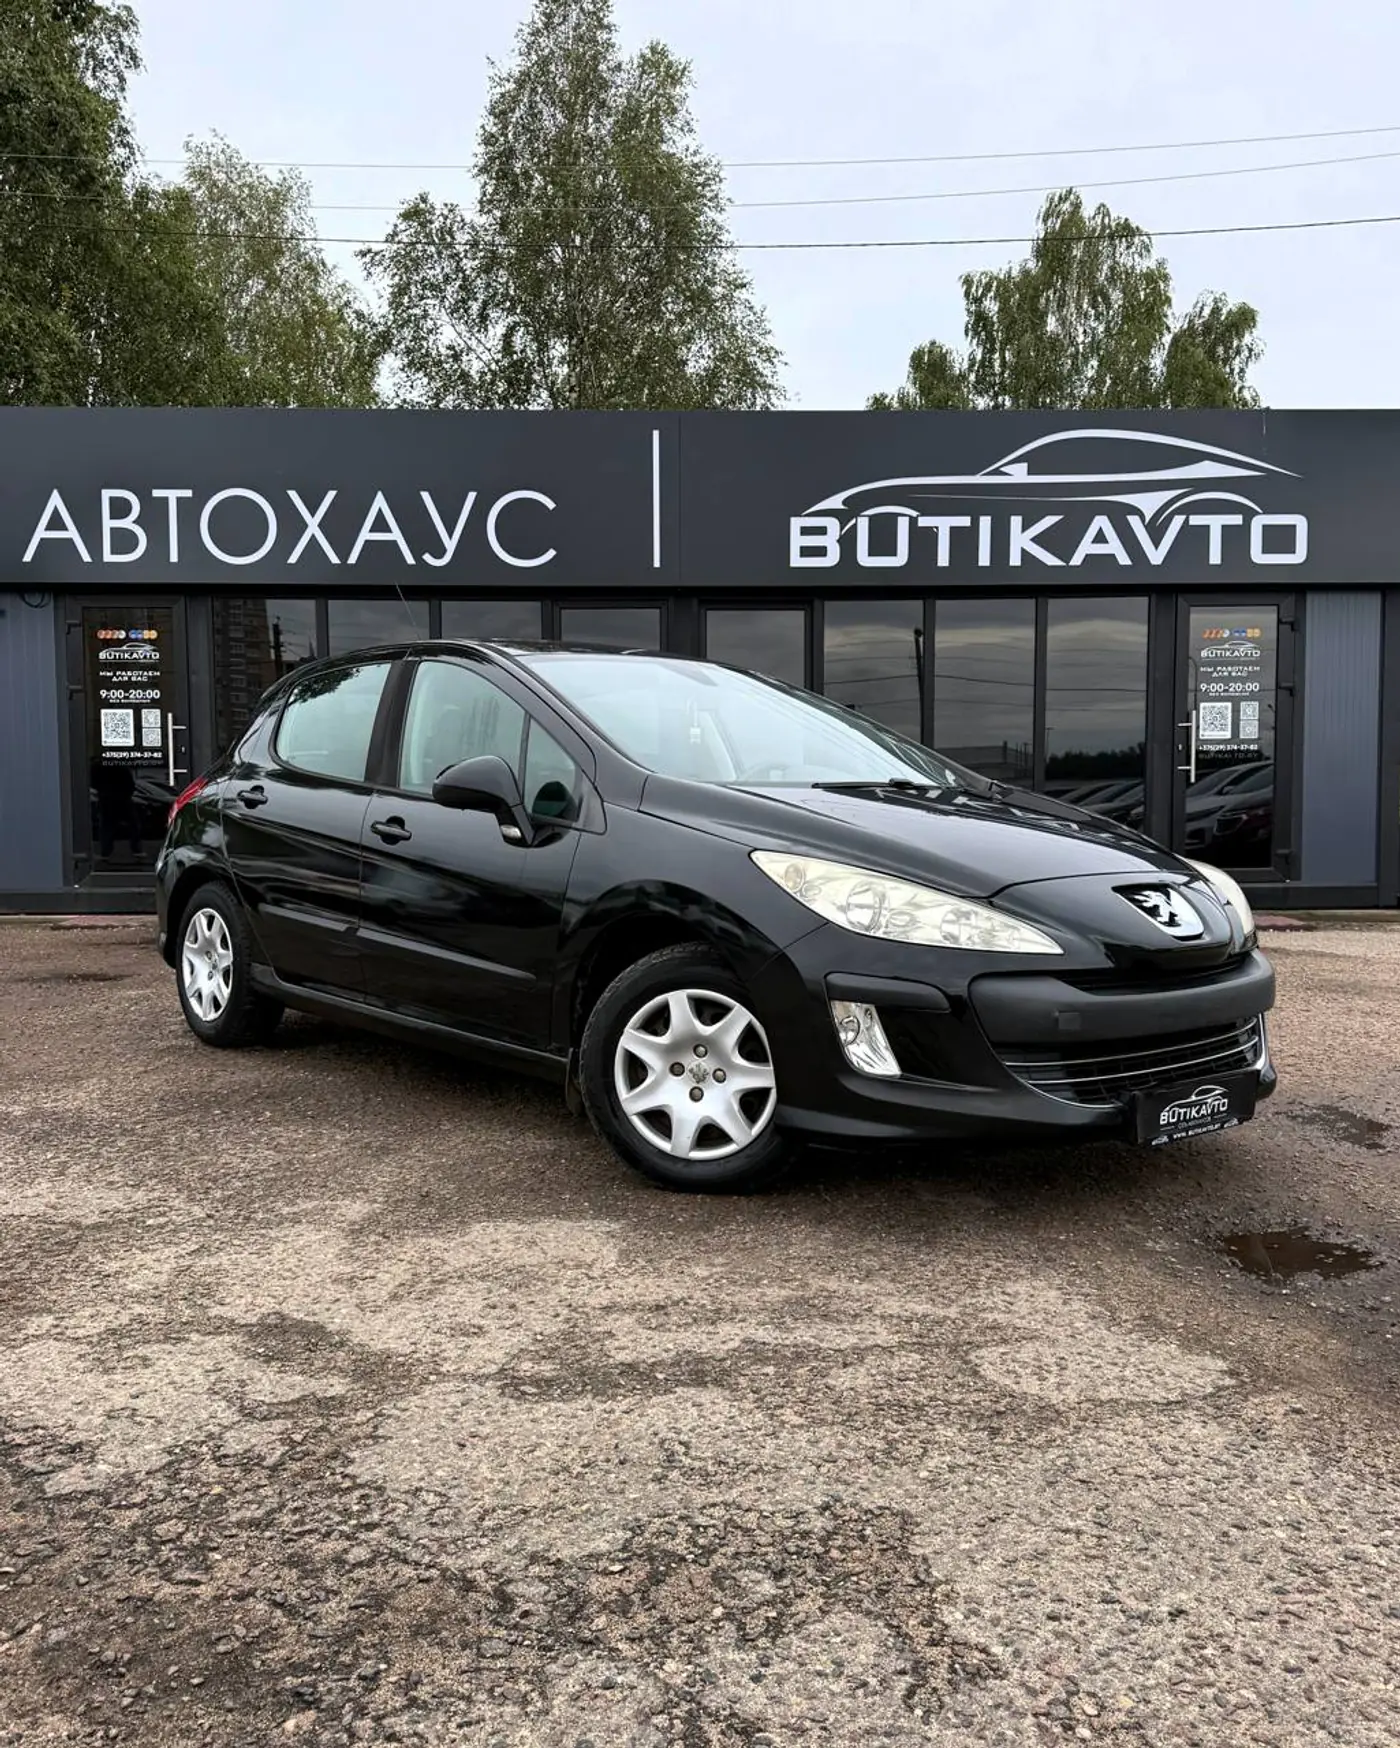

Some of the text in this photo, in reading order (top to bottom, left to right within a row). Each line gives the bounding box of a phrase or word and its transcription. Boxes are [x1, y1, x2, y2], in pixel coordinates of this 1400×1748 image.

[22, 487, 558, 568] АВТОХАУС
[788, 513, 1309, 568] BUTIKAVTO
[98, 651, 160, 660] BUTIKAVTO
[1200, 650, 1261, 658] BUTIKAVTO
[1200, 682, 1260, 692] 9:00-20:00
[99, 689, 161, 699] 9:00-20:00
[1159, 1098, 1229, 1125] BUTIKAVTO
